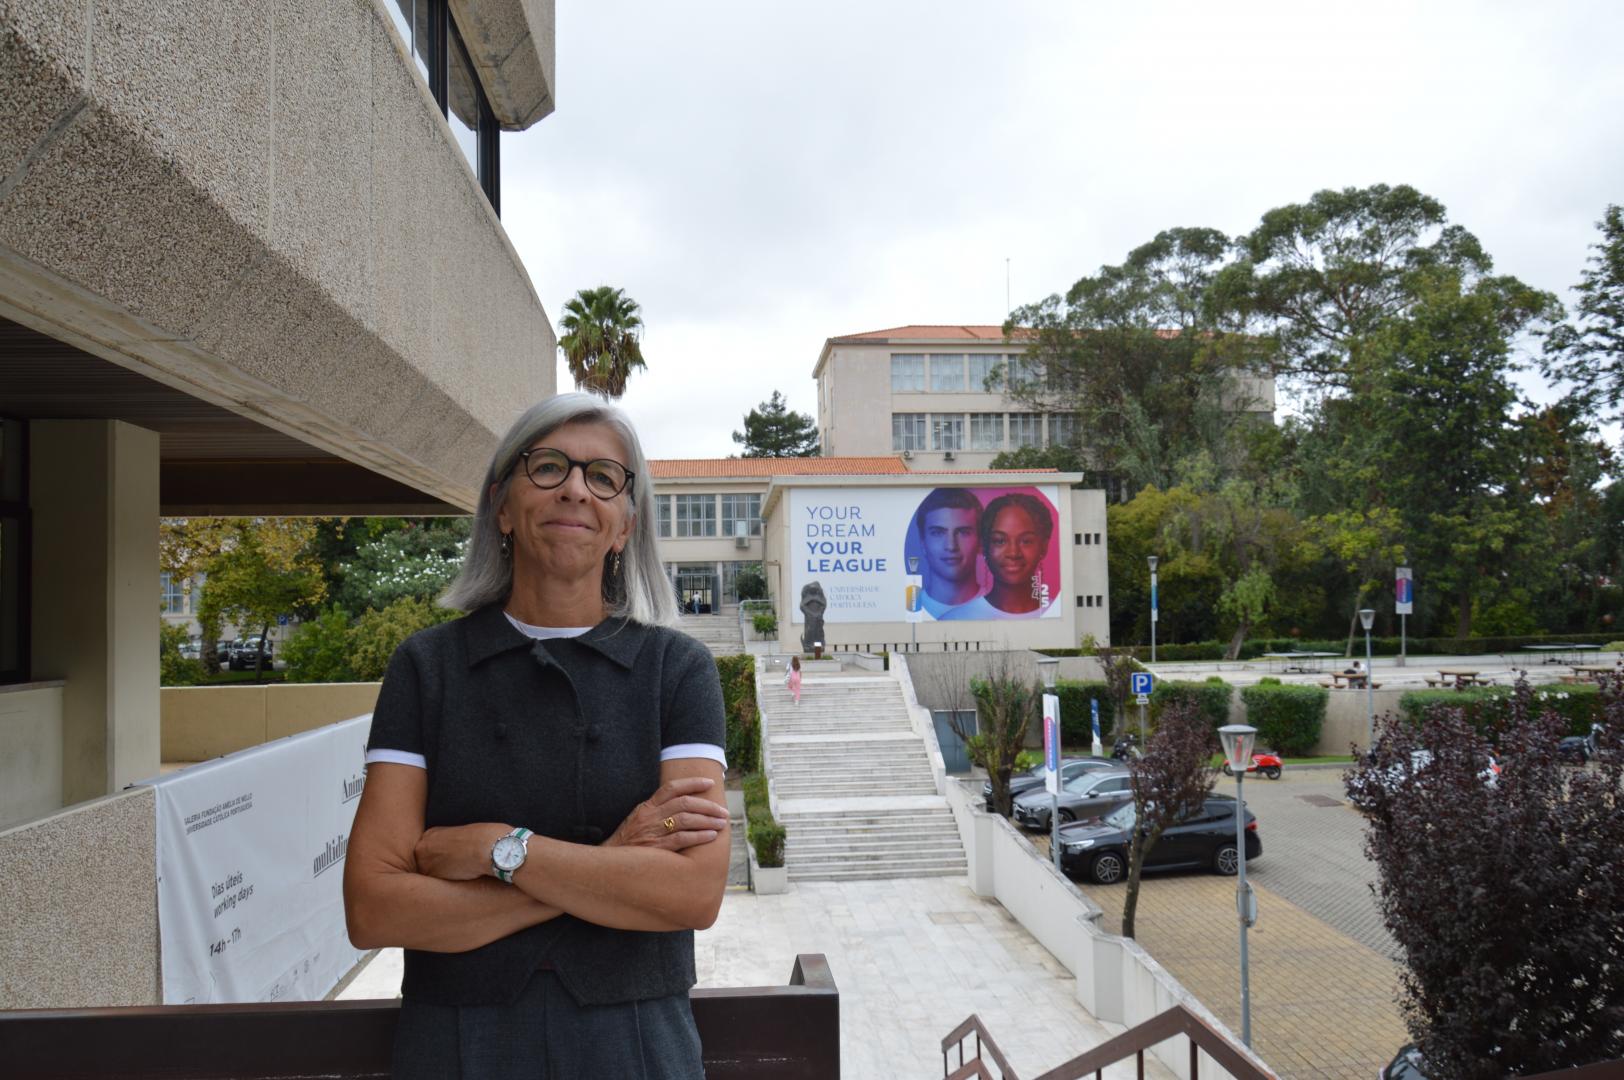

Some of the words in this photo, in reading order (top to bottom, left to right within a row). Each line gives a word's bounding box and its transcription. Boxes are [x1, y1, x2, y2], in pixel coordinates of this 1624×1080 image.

[806, 506, 862, 520] YOUR
[806, 524, 875, 538] DREAM
[806, 541, 863, 555] YOUR
[807, 558, 887, 573] LEAGUE
[1136, 675, 1148, 692] P
[211, 882, 225, 899] Dias
[226, 871, 243, 890] úteis
[214, 894, 237, 919] working
[237, 884, 254, 901] days
